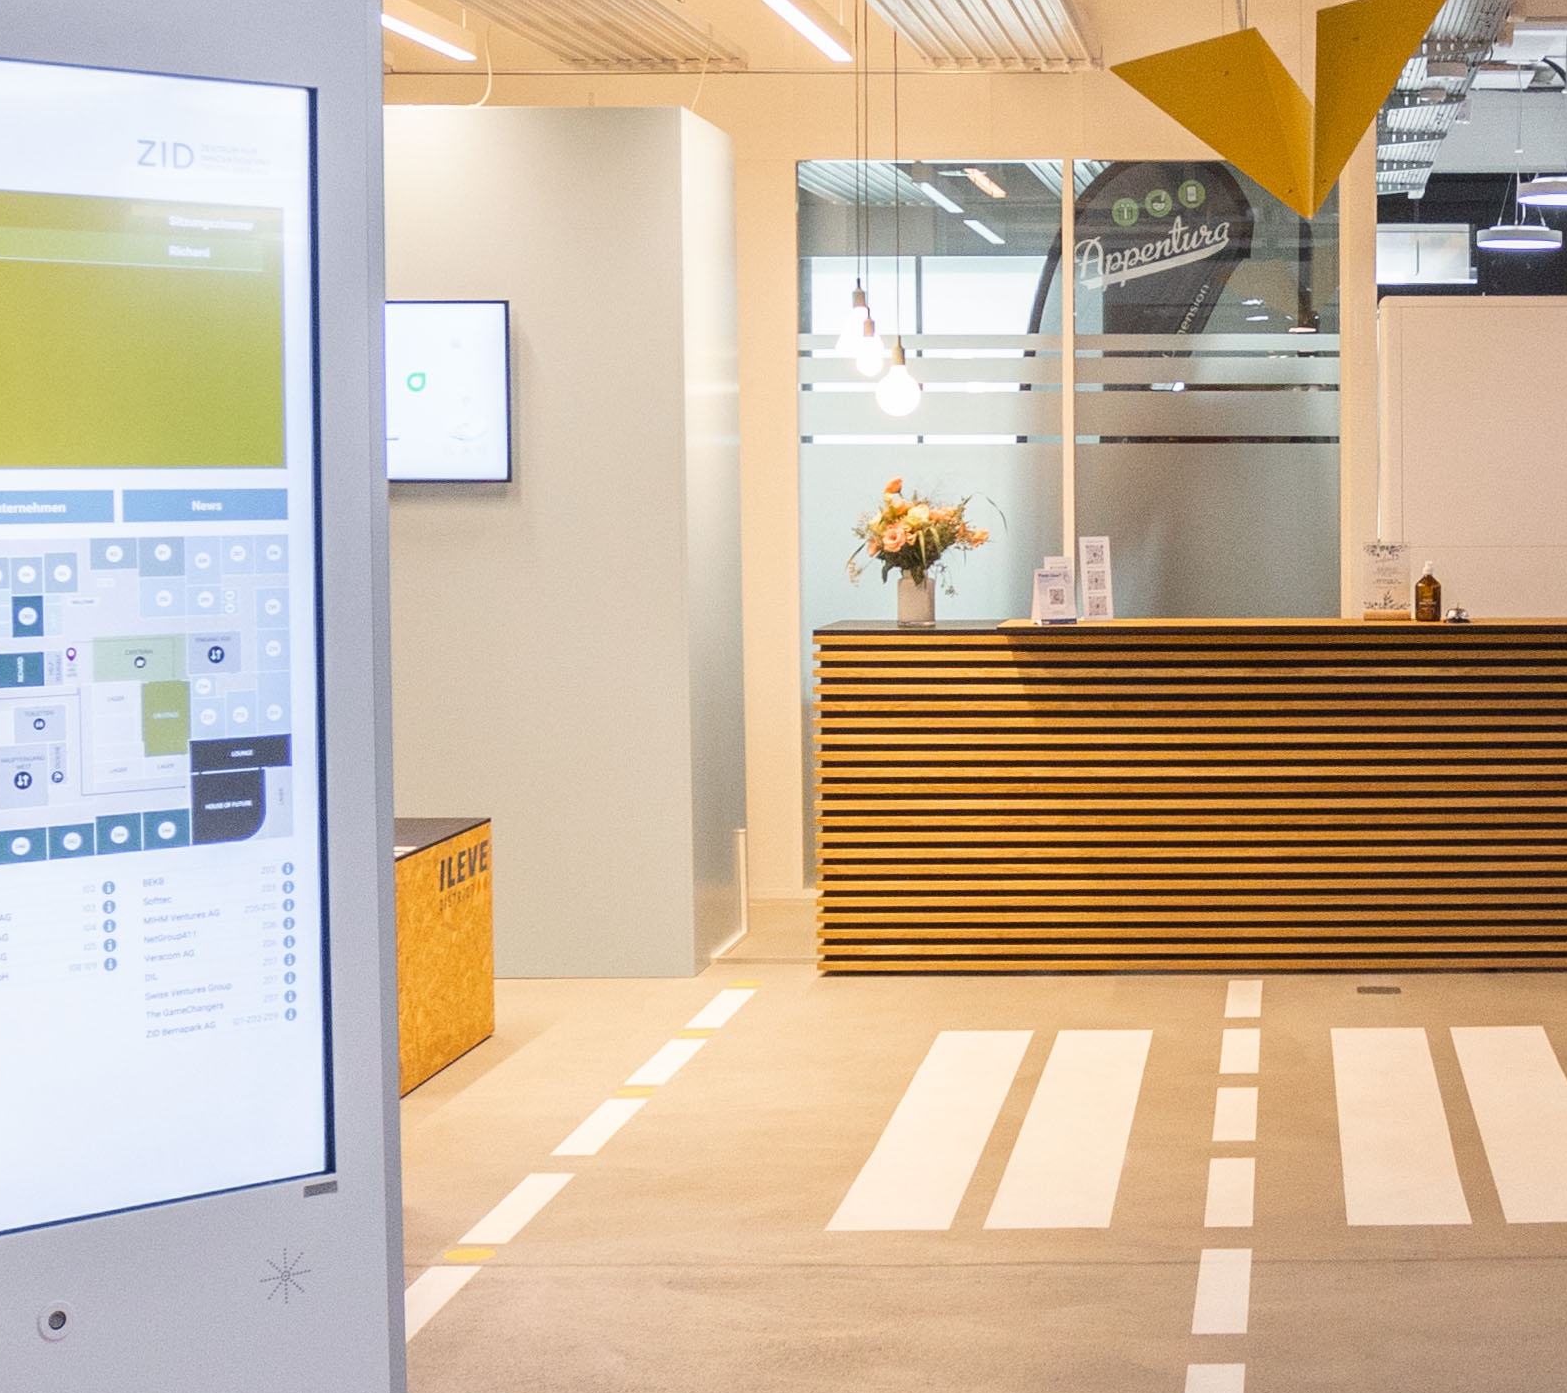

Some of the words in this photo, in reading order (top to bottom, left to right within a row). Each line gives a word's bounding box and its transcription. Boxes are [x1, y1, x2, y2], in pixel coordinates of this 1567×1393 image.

[137, 139, 195, 169] ZID
[1074, 215, 1230, 292] Appentura
[191, 500, 224, 513] News
[440, 840, 488, 892] ILEVE
[171, 911, 206, 922] Ventures
[208, 909, 220, 917] AG
[182, 949, 195, 958] AG
[171, 986, 206, 997] Ventures
[208, 983, 232, 992] Group
[146, 1011, 161, 1019] The
[204, 1021, 216, 1030] AG
